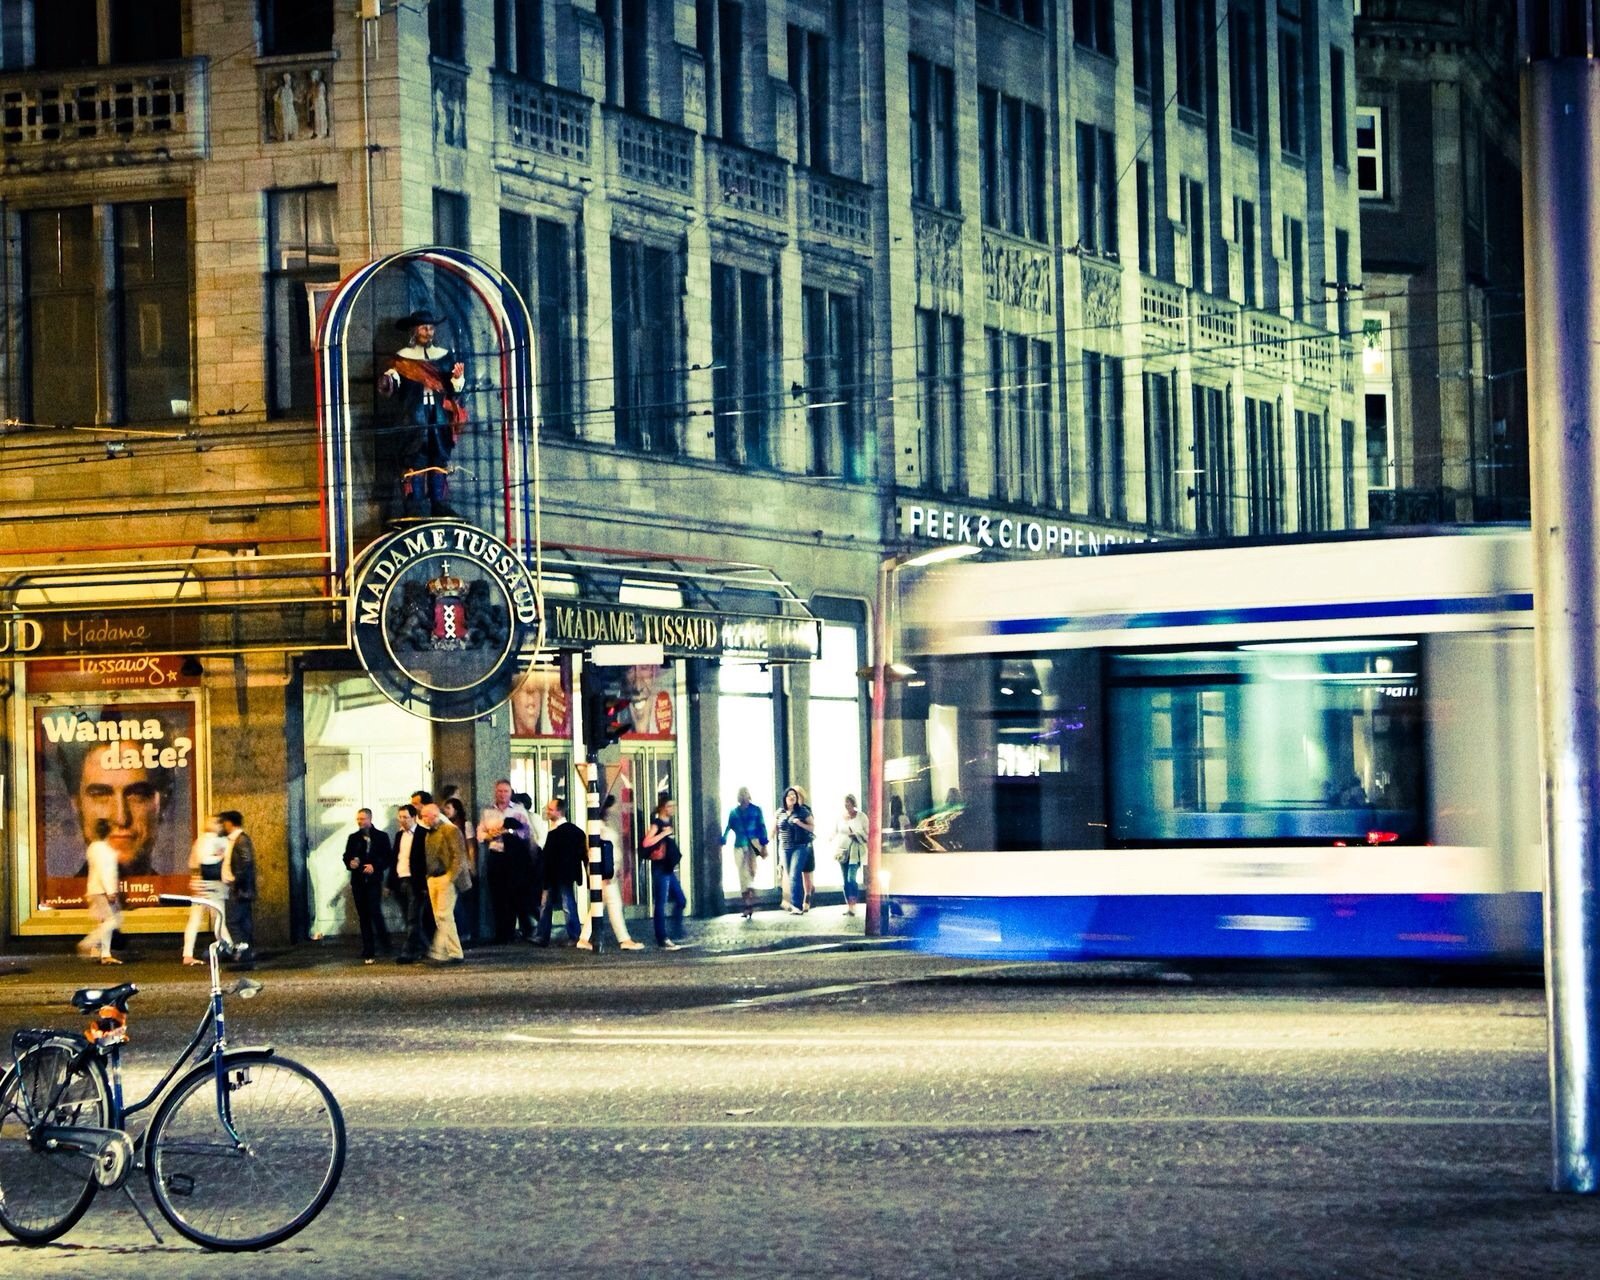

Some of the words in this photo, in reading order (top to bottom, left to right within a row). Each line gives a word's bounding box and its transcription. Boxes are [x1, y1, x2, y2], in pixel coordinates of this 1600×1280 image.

[910, 506, 971, 543] PEEK
[998, 518, 1158, 556] CLOPPEN
[360, 528, 448, 625] MADAME
[453, 528, 536, 624] TUSSAUD
[63, 618, 151, 647] Madame
[556, 606, 637, 643] MADAME
[642, 613, 718, 649] TUSSAUD
[101, 676, 145, 685] AMSTERDAM
[42, 715, 164, 743] Wanna
[101, 737, 192, 770] date?
